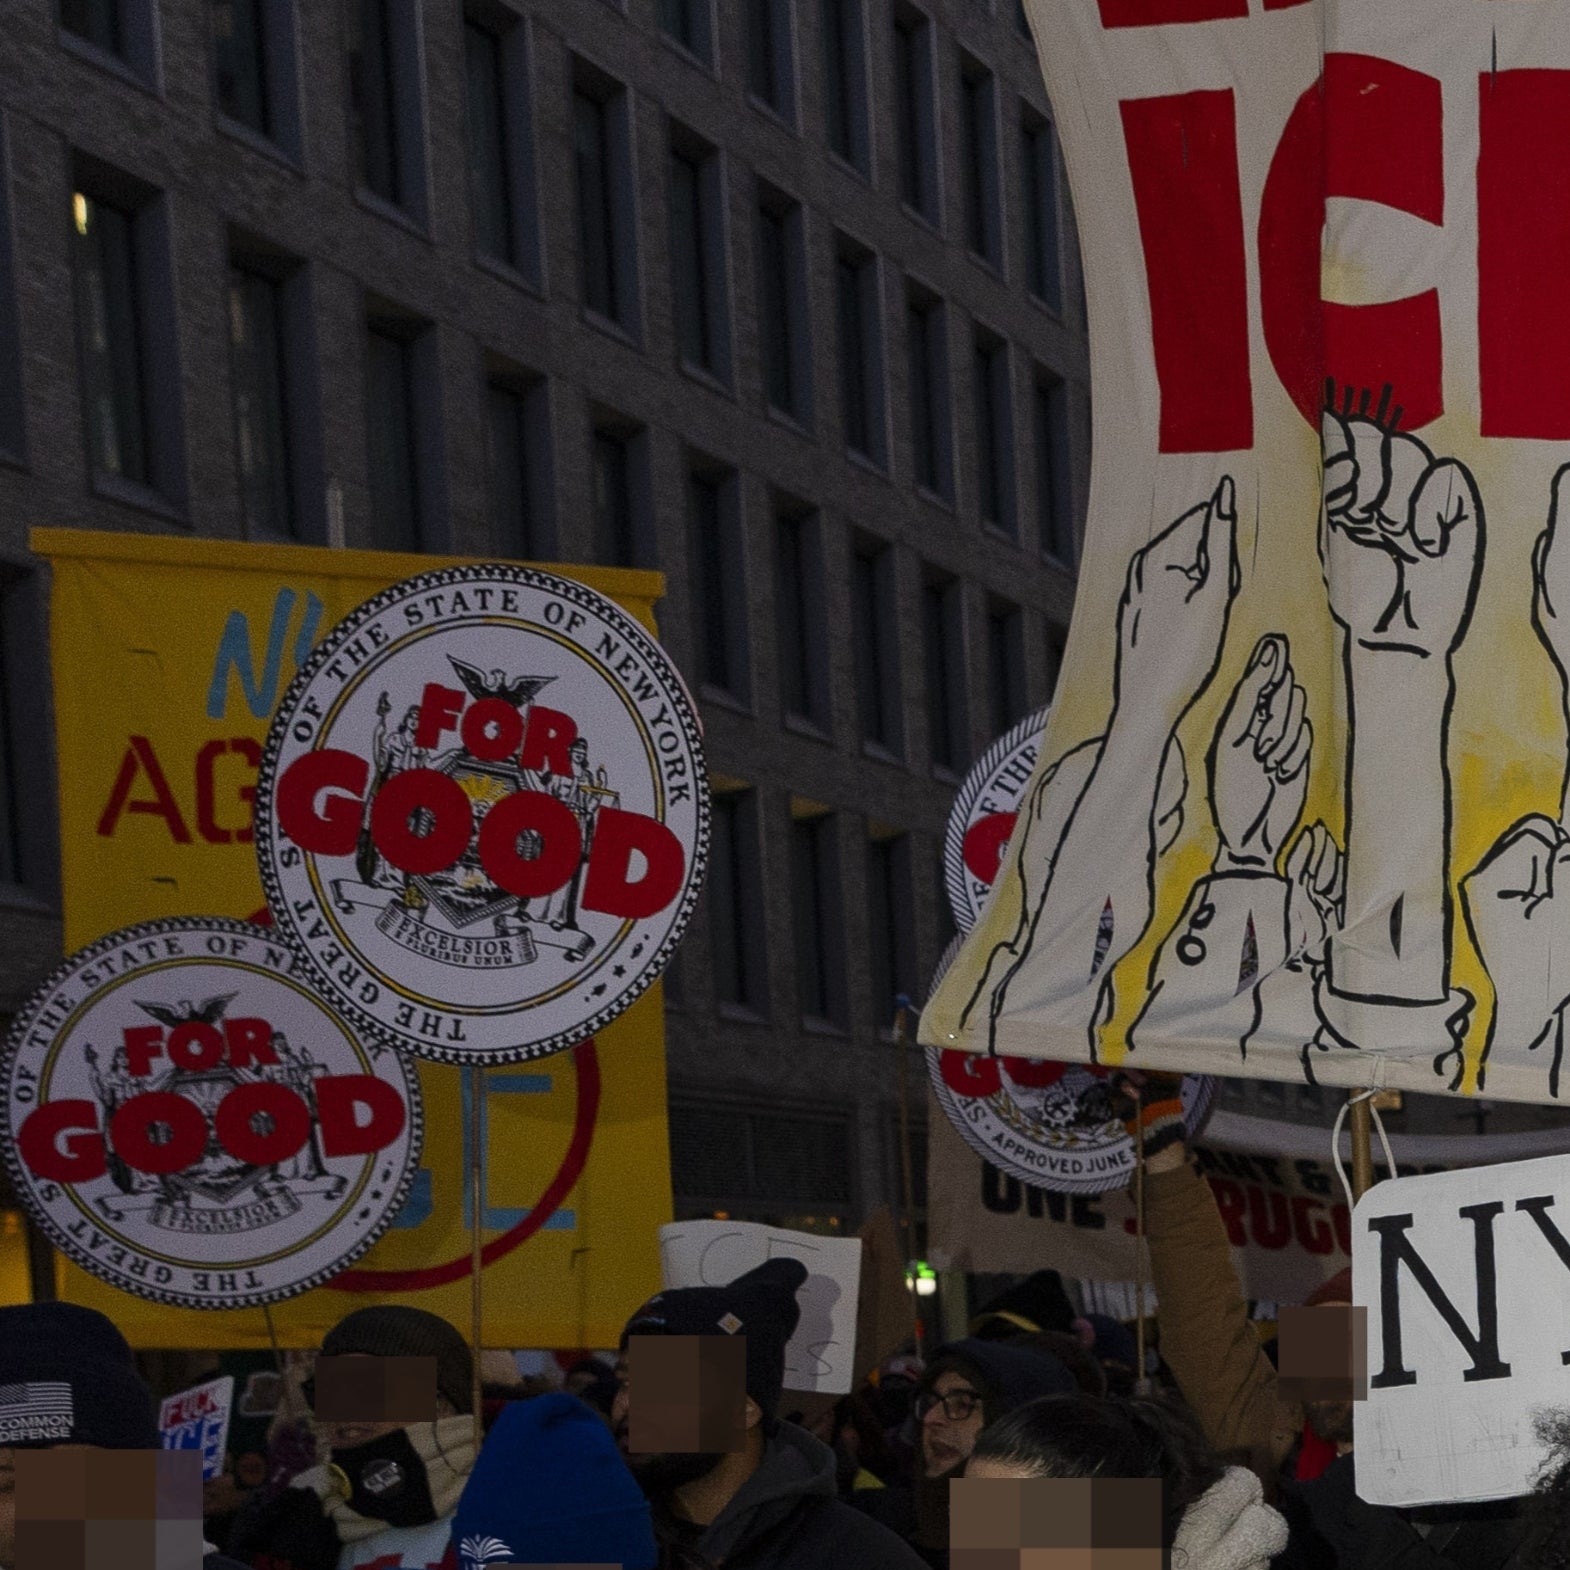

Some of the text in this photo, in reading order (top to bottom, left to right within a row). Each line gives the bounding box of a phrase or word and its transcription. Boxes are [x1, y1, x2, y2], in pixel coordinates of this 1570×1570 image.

[292, 588, 690, 806] OF THE STATE OF NEW YORK
[415, 683, 577, 777] FOR
[277, 749, 685, 918] GOOD
[400, 913, 512, 955] EXCELSIOR
[293, 900, 466, 1042] THE GREAT
[16, 1064, 38, 1102] OF
[29, 998, 74, 1051] THE
[80, 937, 184, 987] STATE
[206, 936, 248, 957] OF
[123, 1018, 280, 1077] FOR
[18, 1074, 405, 1183] GOOD
[992, 1132, 1130, 1174] APPROVED JUNE
[67, 1219, 173, 1285] GREAT
[192, 1270, 263, 1292] THE
[0, 1415, 75, 1431] COMMON
[0, 1427, 72, 1443] DEFENSE
